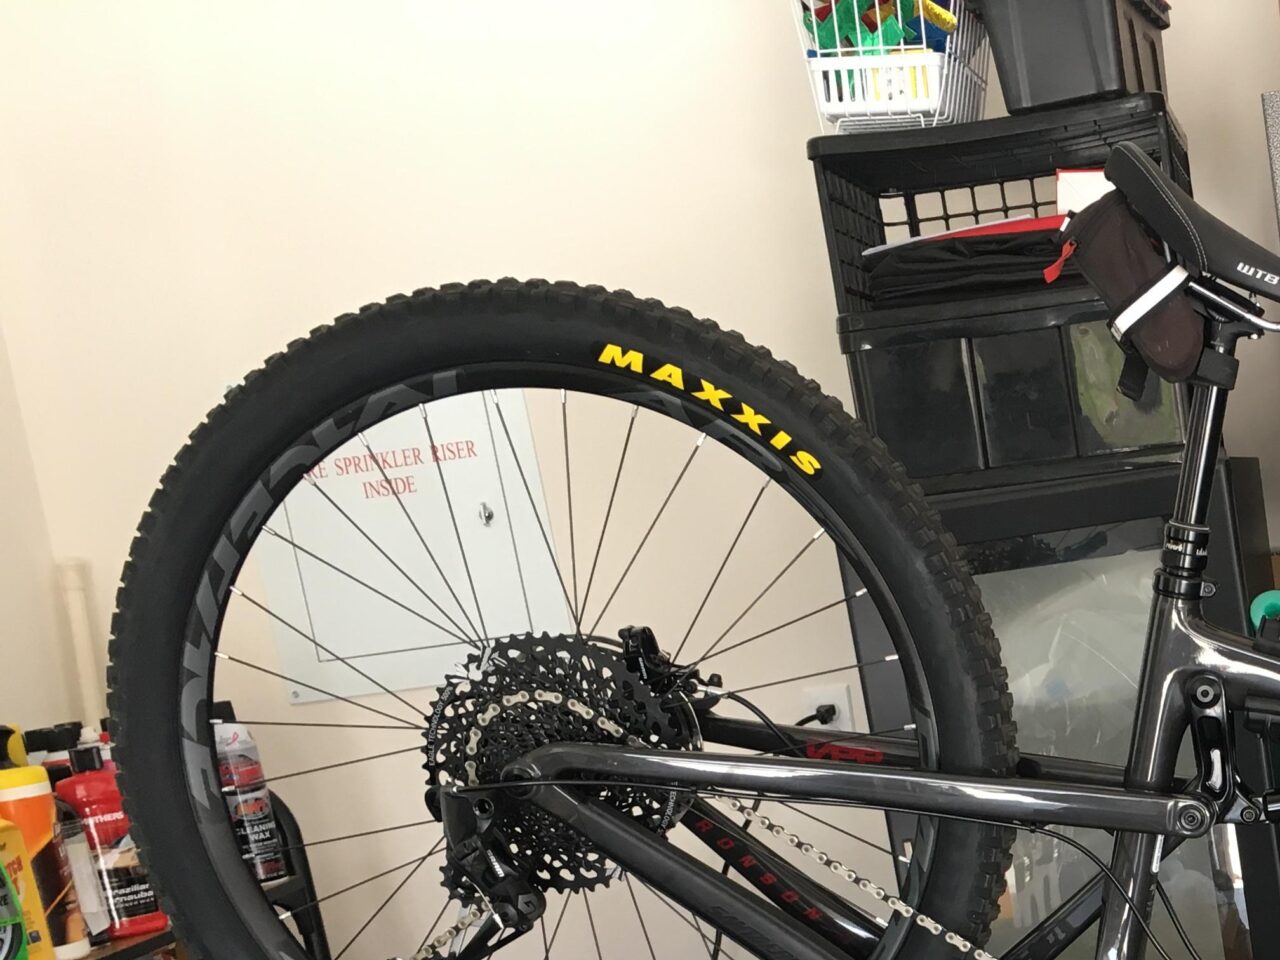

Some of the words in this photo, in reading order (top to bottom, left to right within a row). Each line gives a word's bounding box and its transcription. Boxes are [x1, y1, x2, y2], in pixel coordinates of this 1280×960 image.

[1236, 261, 1280, 286] WTB
[598, 343, 822, 475] MAXXIS
[334, 446, 424, 477] SPRINKLER
[430, 440, 478, 463] RISER
[363, 476, 417, 499] INSIDE
[430, 702, 445, 744] TECHNOLOGY
[428, 745, 437, 767] EAGLE
[696, 819, 823, 921] RONSON
[111, 883, 150, 896] razilia
[113, 890, 154, 904] rnauba
